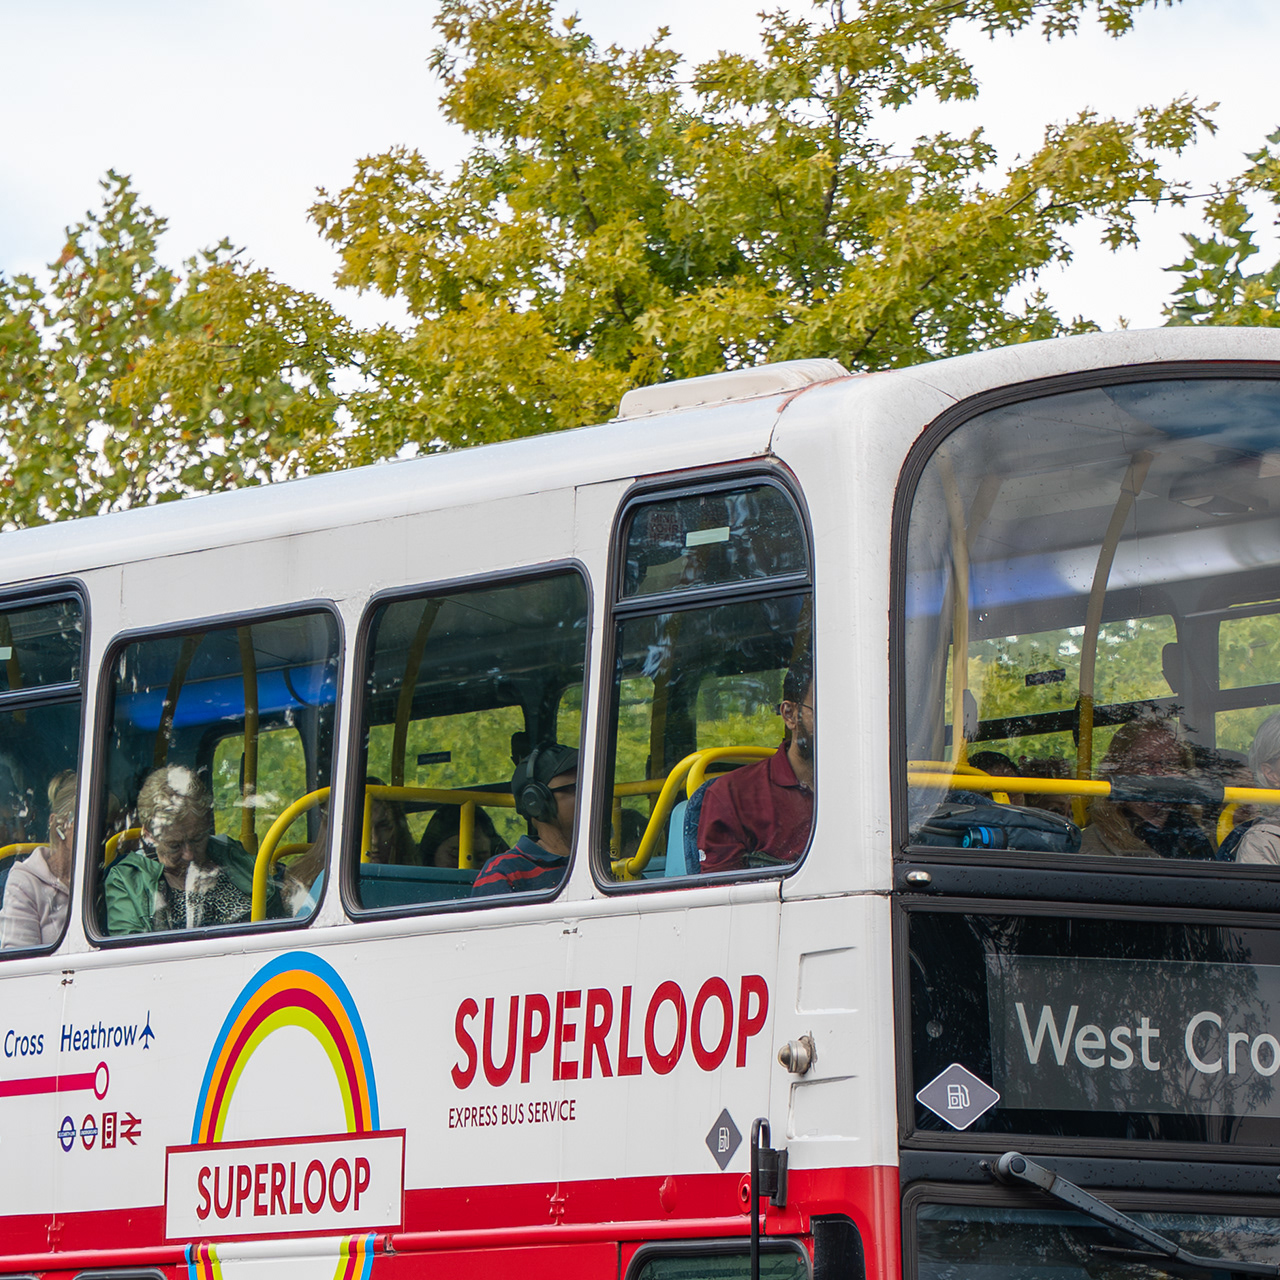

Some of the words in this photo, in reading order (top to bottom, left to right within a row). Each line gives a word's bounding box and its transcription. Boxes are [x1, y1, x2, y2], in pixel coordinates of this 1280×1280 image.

[4, 1029, 44, 1058] Cross
[60, 1021, 138, 1052] Heathrow
[450, 973, 769, 1091] SUPERLOOP
[1015, 1002, 1159, 1071] West
[449, 1105, 497, 1128] EXPRESS
[502, 1103, 524, 1125] BUS
[528, 1099, 576, 1123] SERVICE
[196, 1157, 371, 1221] SUPERLOOP
